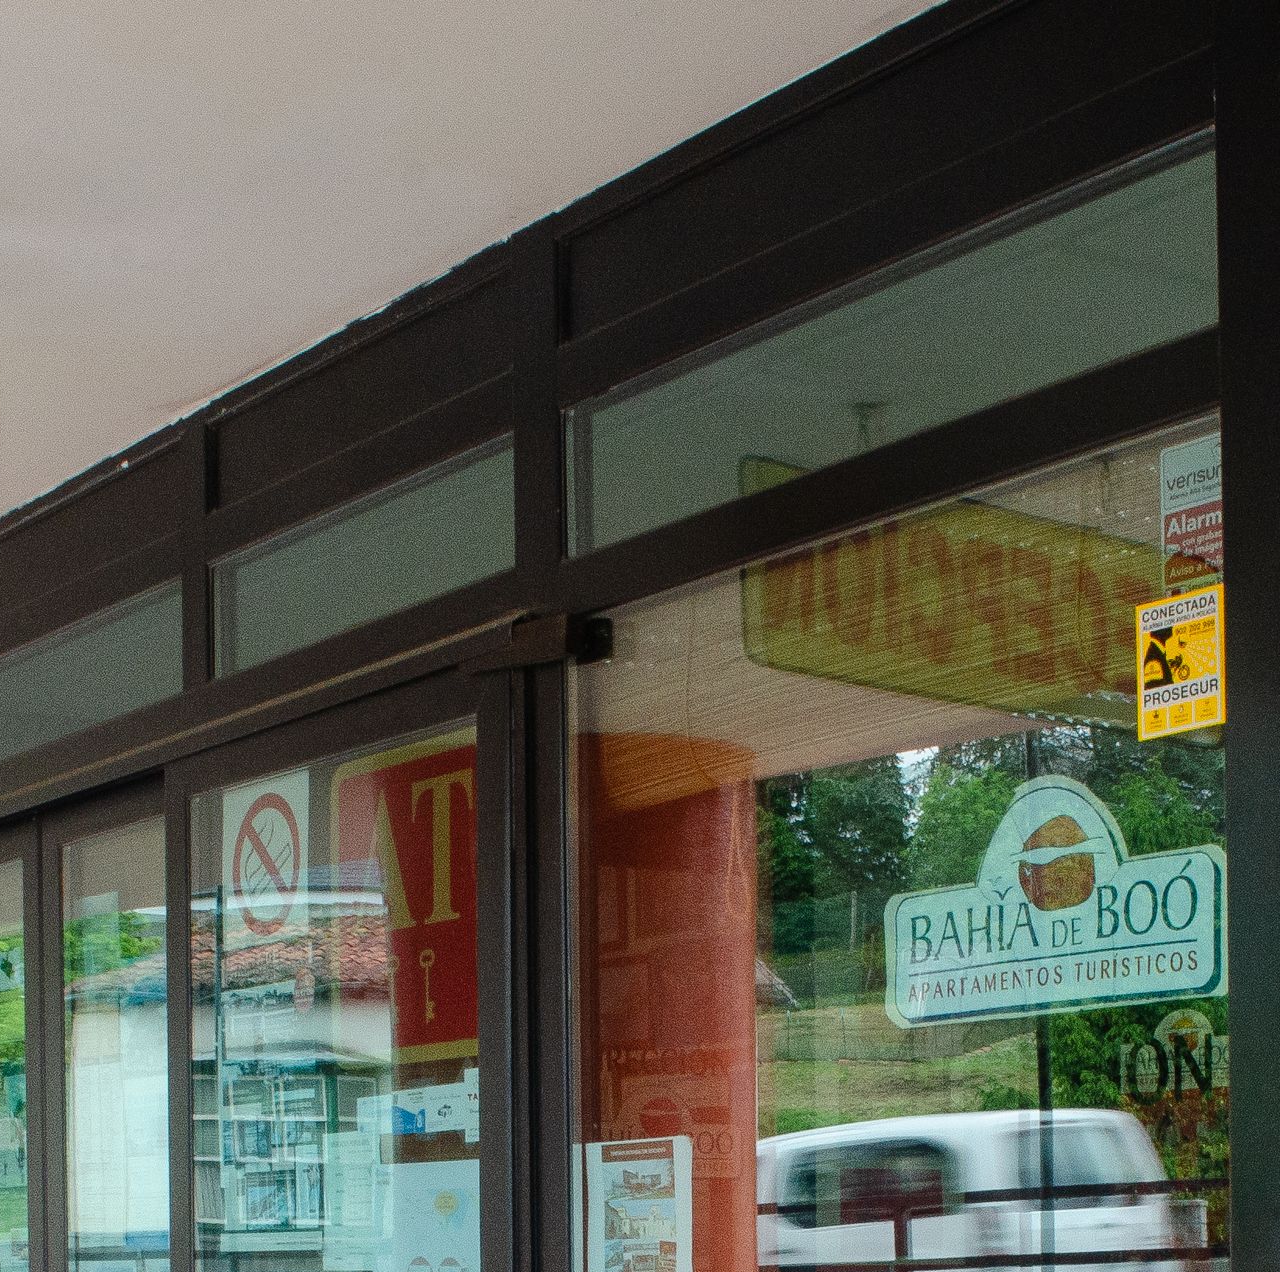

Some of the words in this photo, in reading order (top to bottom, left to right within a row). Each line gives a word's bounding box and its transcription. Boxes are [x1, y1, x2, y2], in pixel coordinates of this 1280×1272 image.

[1142, 594, 1216, 623] CONECTADA
[1144, 678, 1218, 708] PROSEGUR
[1052, 917, 1083, 948] DE
[1096, 859, 1198, 939] BOÓ
[909, 965, 1063, 1001] APARTAMENTOS
